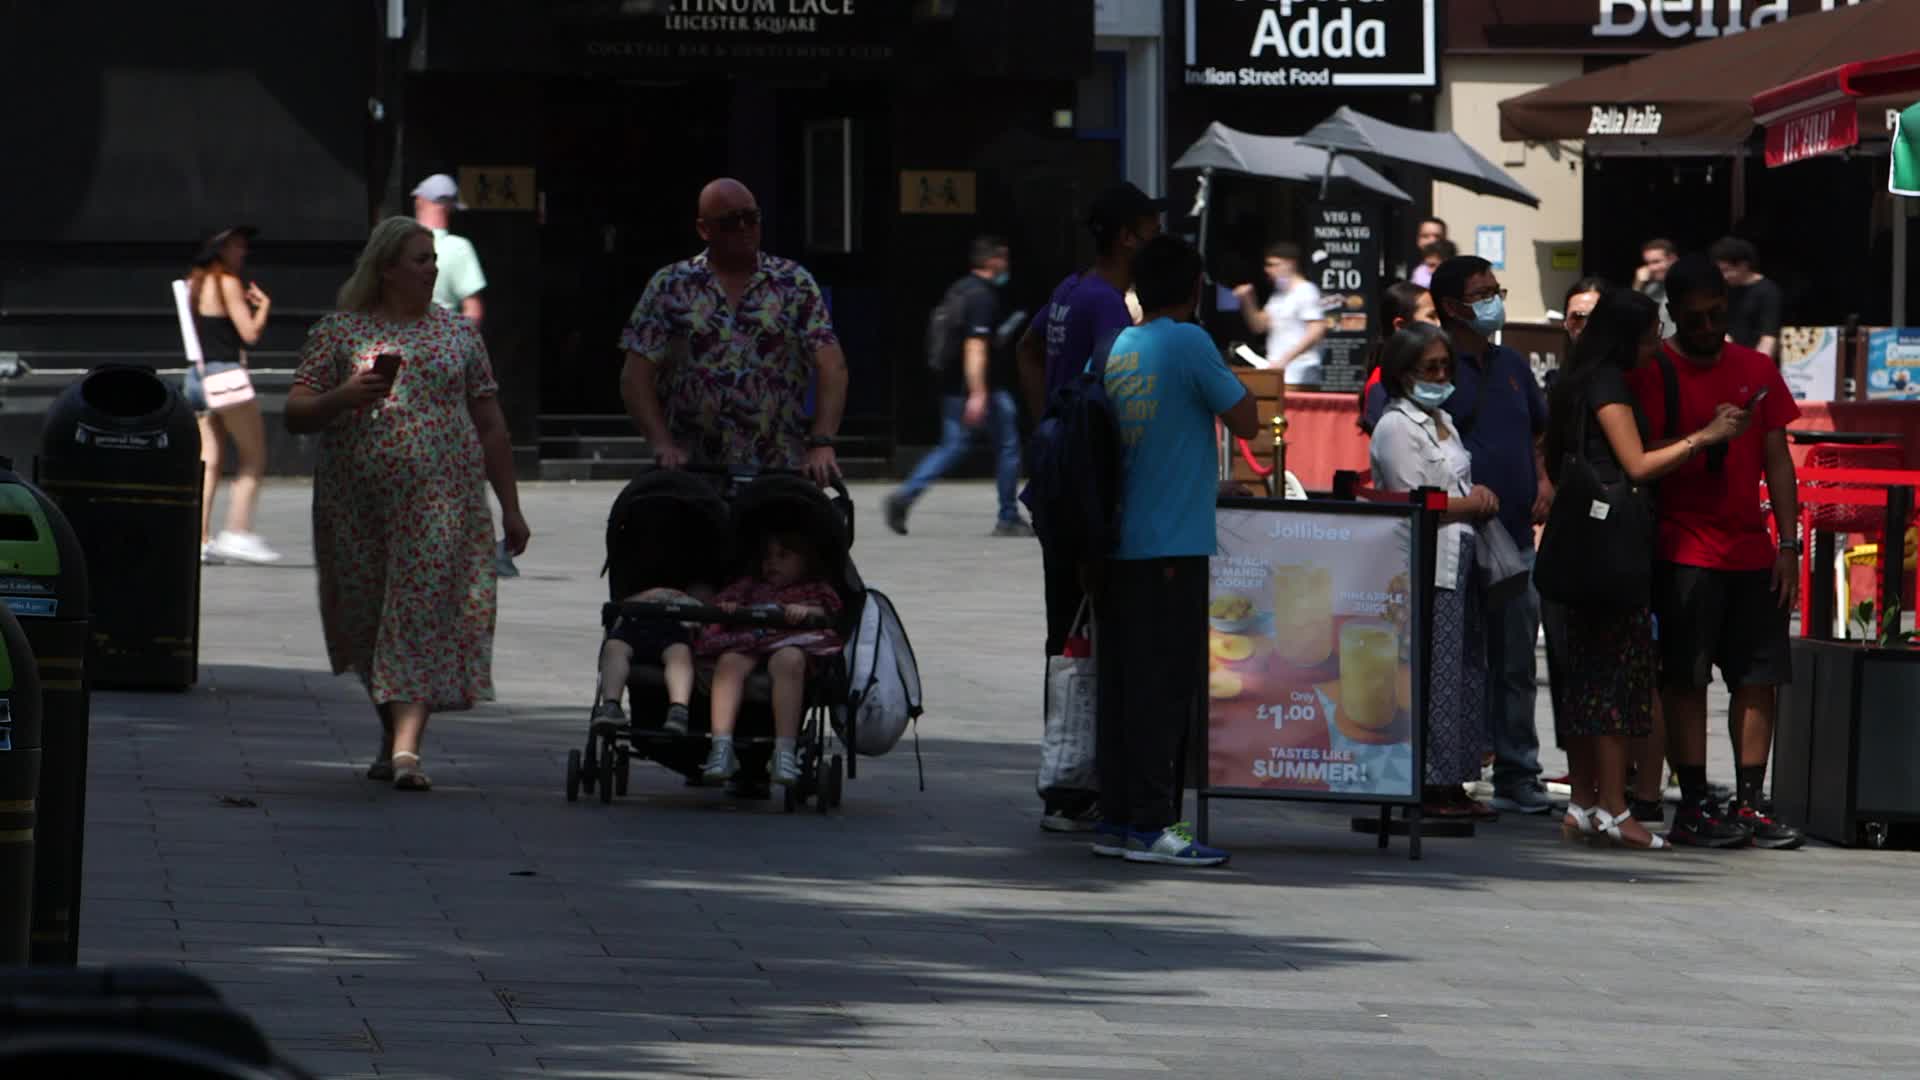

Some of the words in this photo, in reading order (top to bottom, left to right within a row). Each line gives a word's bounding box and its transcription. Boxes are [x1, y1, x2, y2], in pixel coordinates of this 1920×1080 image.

[664, 15, 748, 31] LEICESTER
[752, 15, 817, 36] SQUARE
[1249, 7, 1387, 59] Adda
[1184, 67, 1237, 86] Indian
[1239, 67, 1287, 86] Street
[1290, 67, 1330, 86] Food
[1587, 105, 1624, 135] Bella
[1624, 104, 1662, 135] Italia
[1322, 210, 1349, 225] VEG
[1313, 225, 1371, 240] NON-VEG
[1321, 268, 1362, 290] £10
[1268, 519, 1353, 542] Jollibee
[1290, 692, 1315, 704] Only
[1256, 704, 1315, 730] £1.00
[1270, 748, 1321, 760] TASTES
[1322, 750, 1352, 761] LIKE
[1252, 759, 1367, 783] SUMMER!
